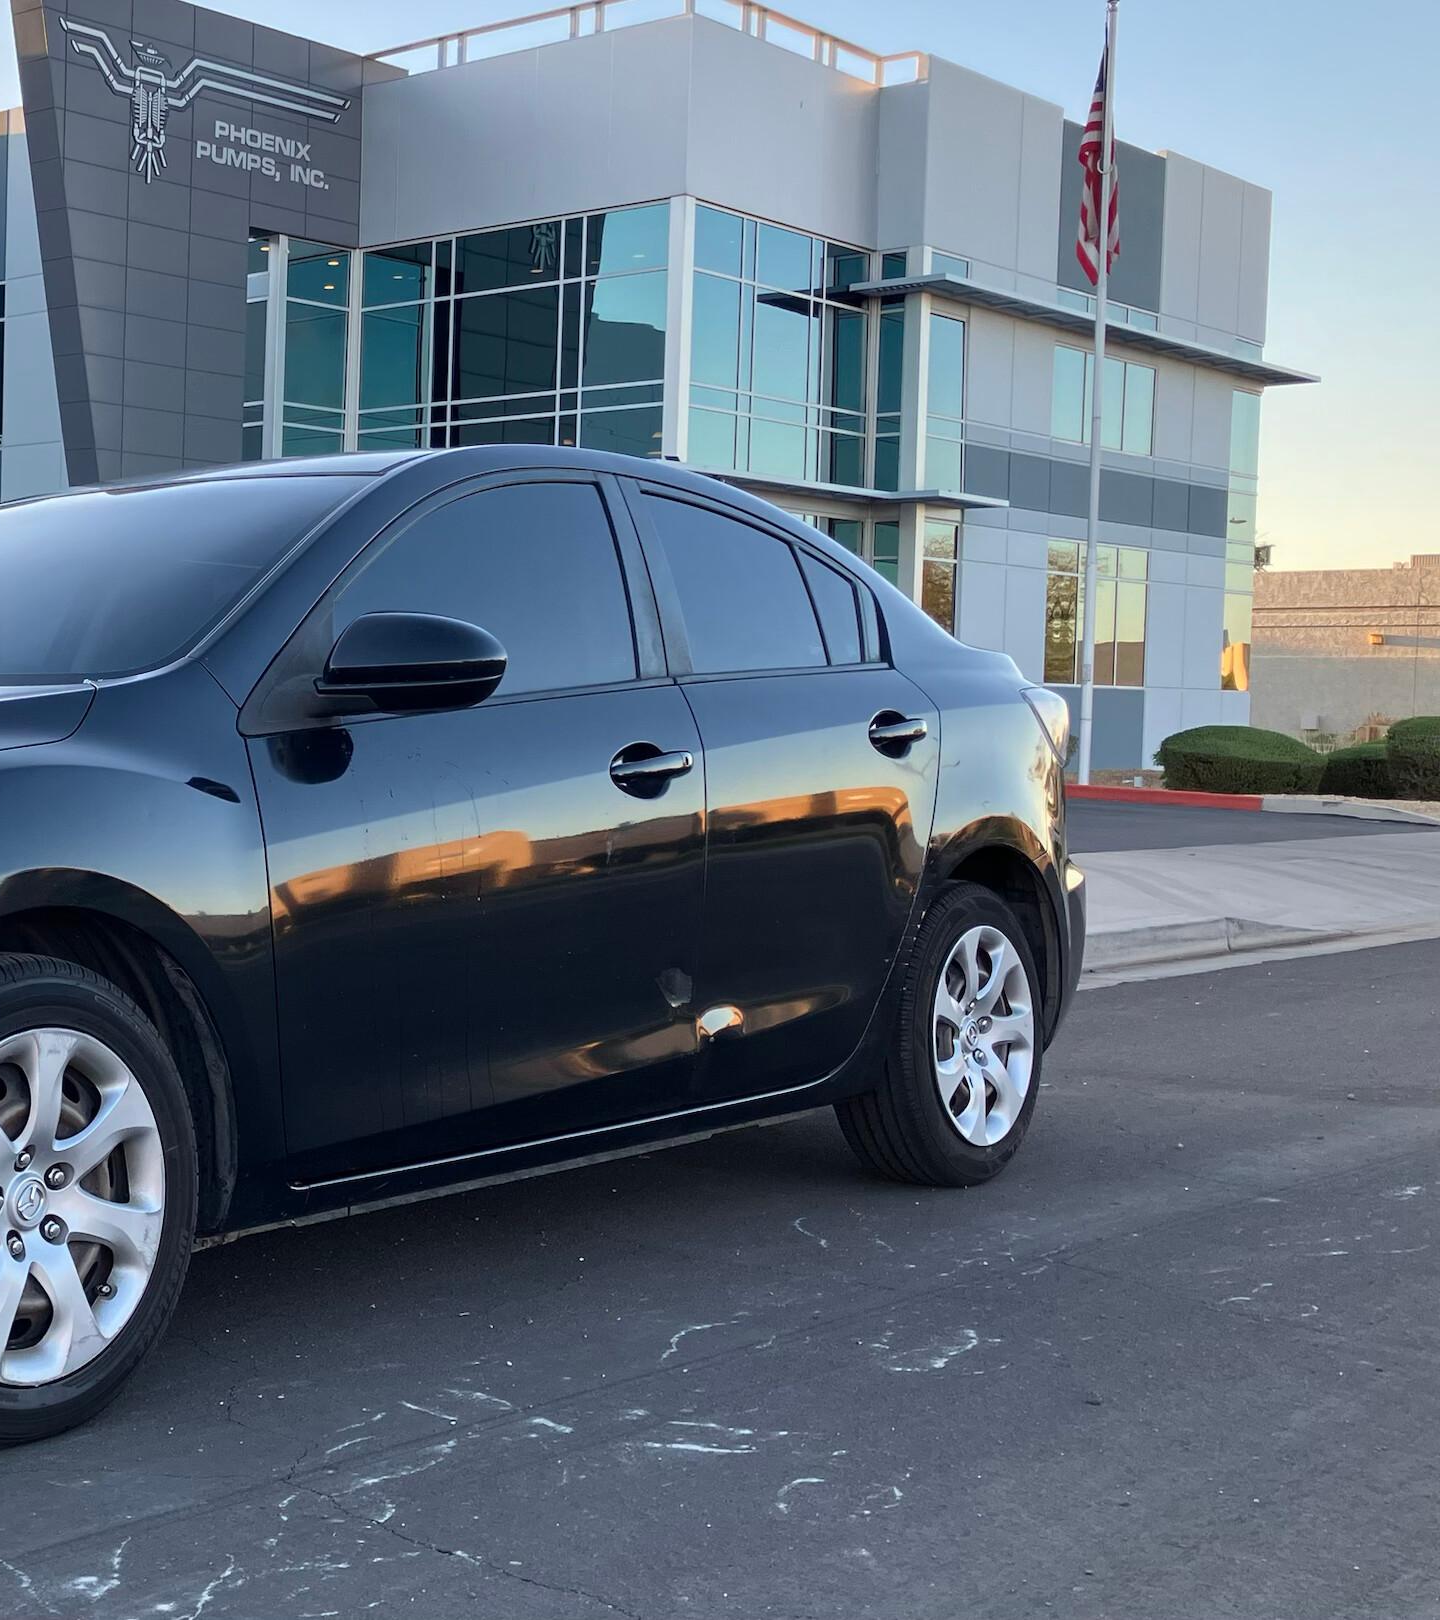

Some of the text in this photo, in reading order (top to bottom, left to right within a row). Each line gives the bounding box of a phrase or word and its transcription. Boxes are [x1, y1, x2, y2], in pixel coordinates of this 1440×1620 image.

[214, 119, 312, 162] PHOENIX
[196, 140, 330, 190] PUMPS, INC.
